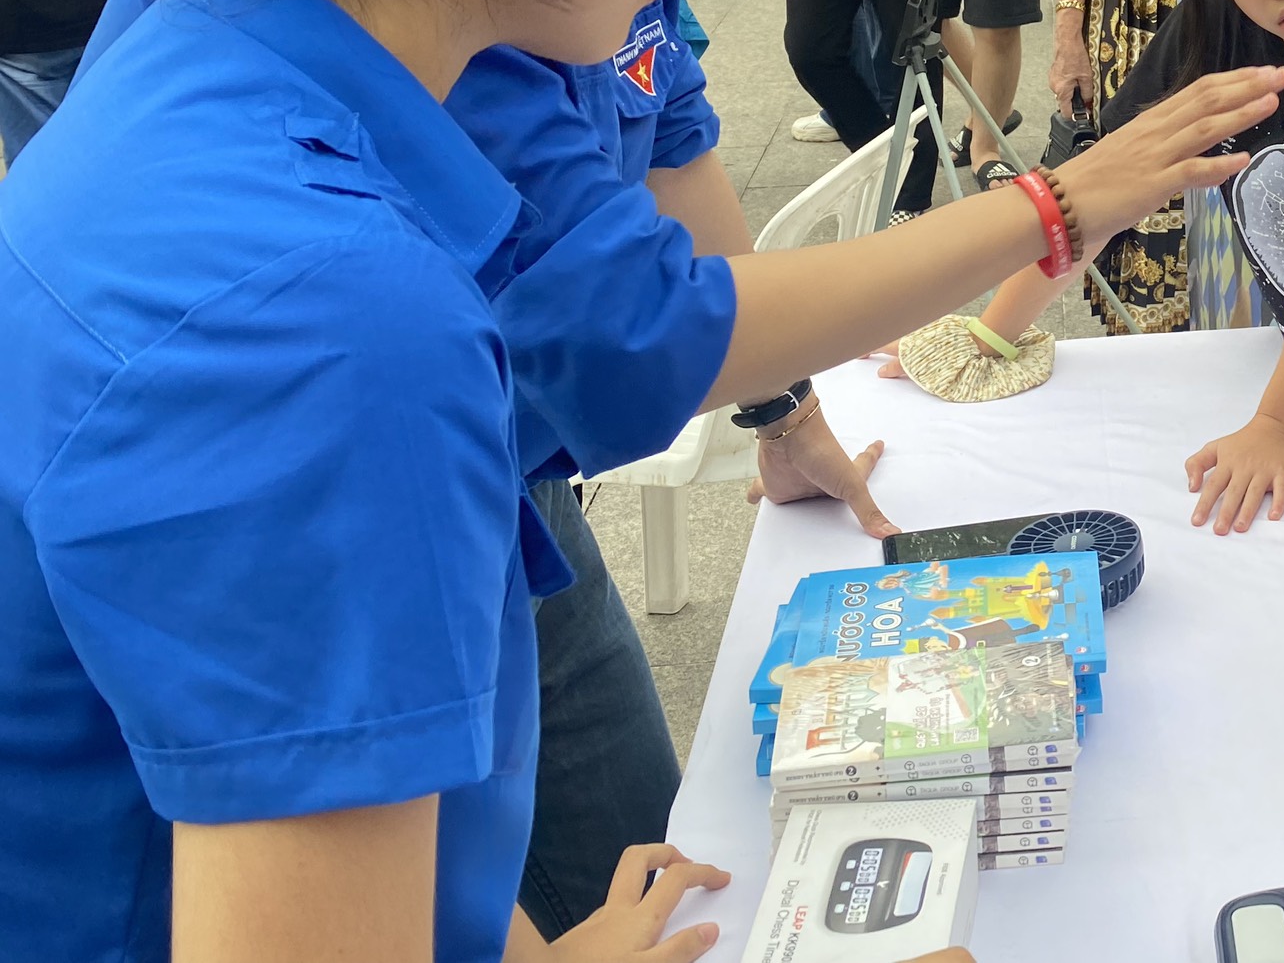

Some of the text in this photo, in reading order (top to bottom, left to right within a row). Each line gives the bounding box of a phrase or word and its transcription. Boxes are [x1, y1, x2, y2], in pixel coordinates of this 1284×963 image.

[839, 582, 870, 608] CỜ
[866, 596, 904, 647] HÒA
[780, 880, 799, 909] Digital
[770, 910, 790, 939] Chess
[792, 905, 808, 931] LEAP
